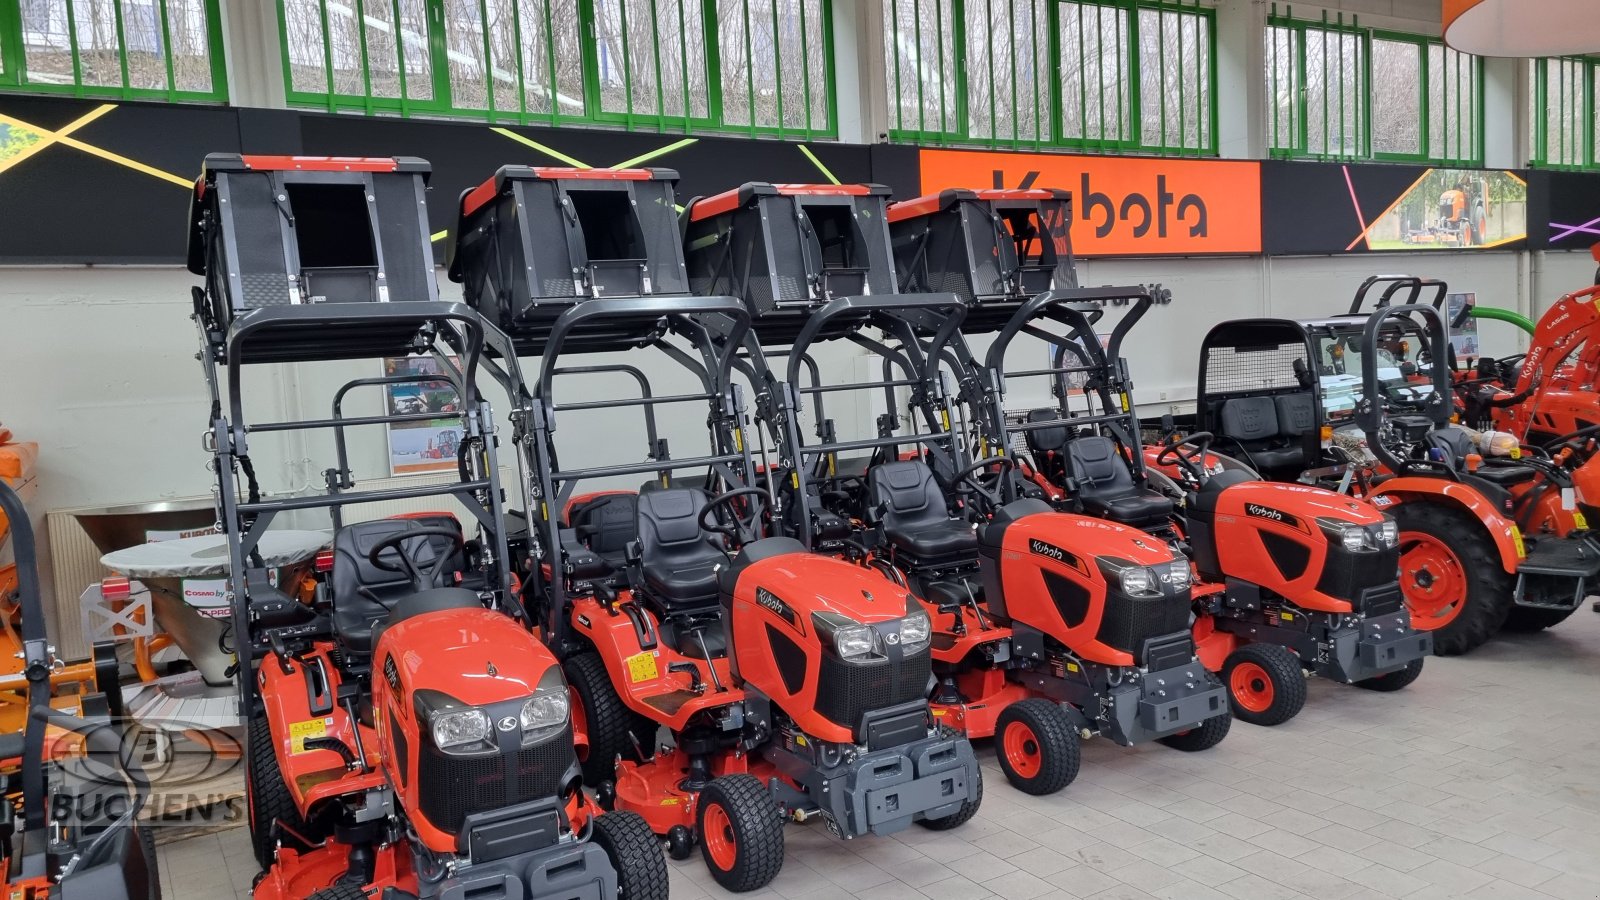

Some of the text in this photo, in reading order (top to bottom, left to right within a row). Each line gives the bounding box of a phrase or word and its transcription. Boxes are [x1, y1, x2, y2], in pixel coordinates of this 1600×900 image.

[993, 170, 1208, 239] bota
[1521, 346, 1542, 379] Kubota
[1249, 504, 1282, 521] Kubota
[1032, 540, 1063, 560] Kubota
[215, 589, 225, 598] by
[758, 588, 783, 614] Kubota
